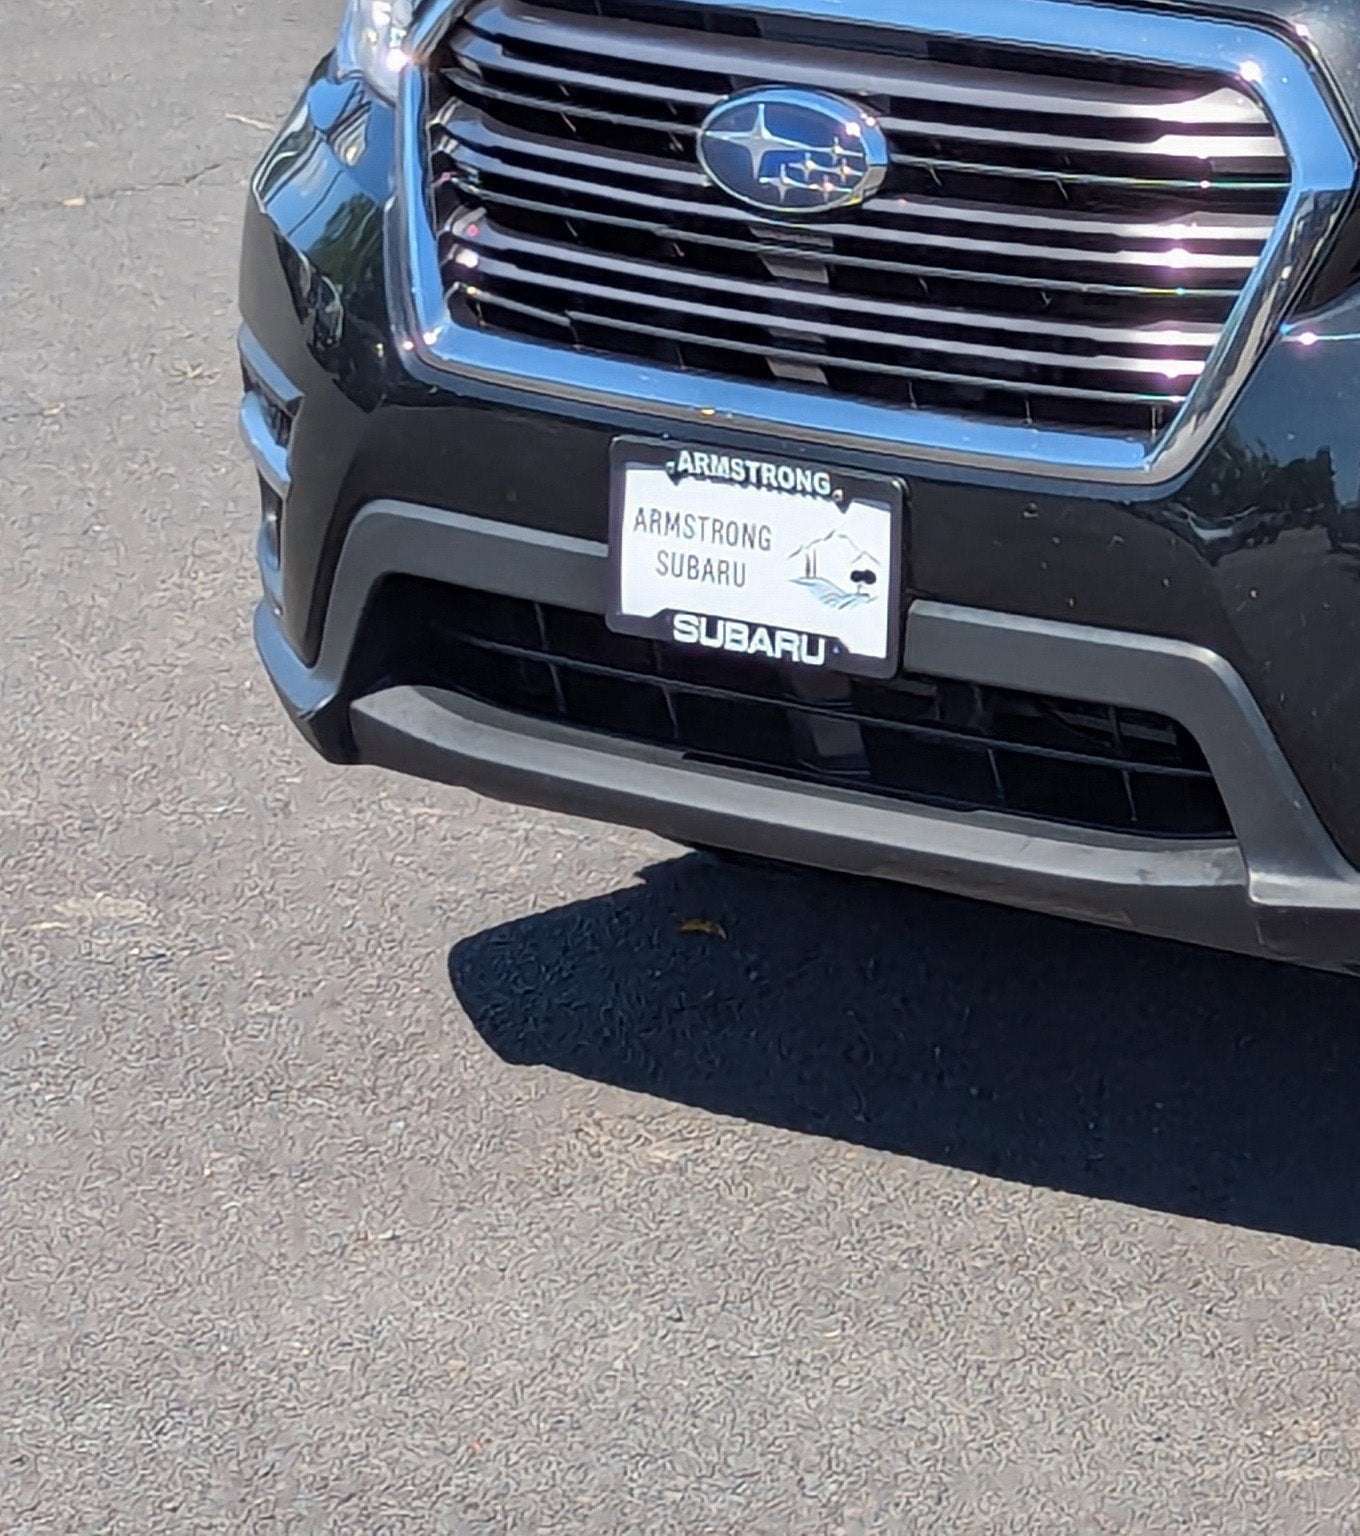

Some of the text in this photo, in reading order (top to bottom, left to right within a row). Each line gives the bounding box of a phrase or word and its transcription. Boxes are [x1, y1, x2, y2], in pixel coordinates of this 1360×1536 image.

[677, 450, 831, 496] ARMSTRONG
[633, 507, 772, 551] ARMSTRONG
[656, 549, 747, 588] SUBARU
[673, 613, 826, 666] SUBARU
